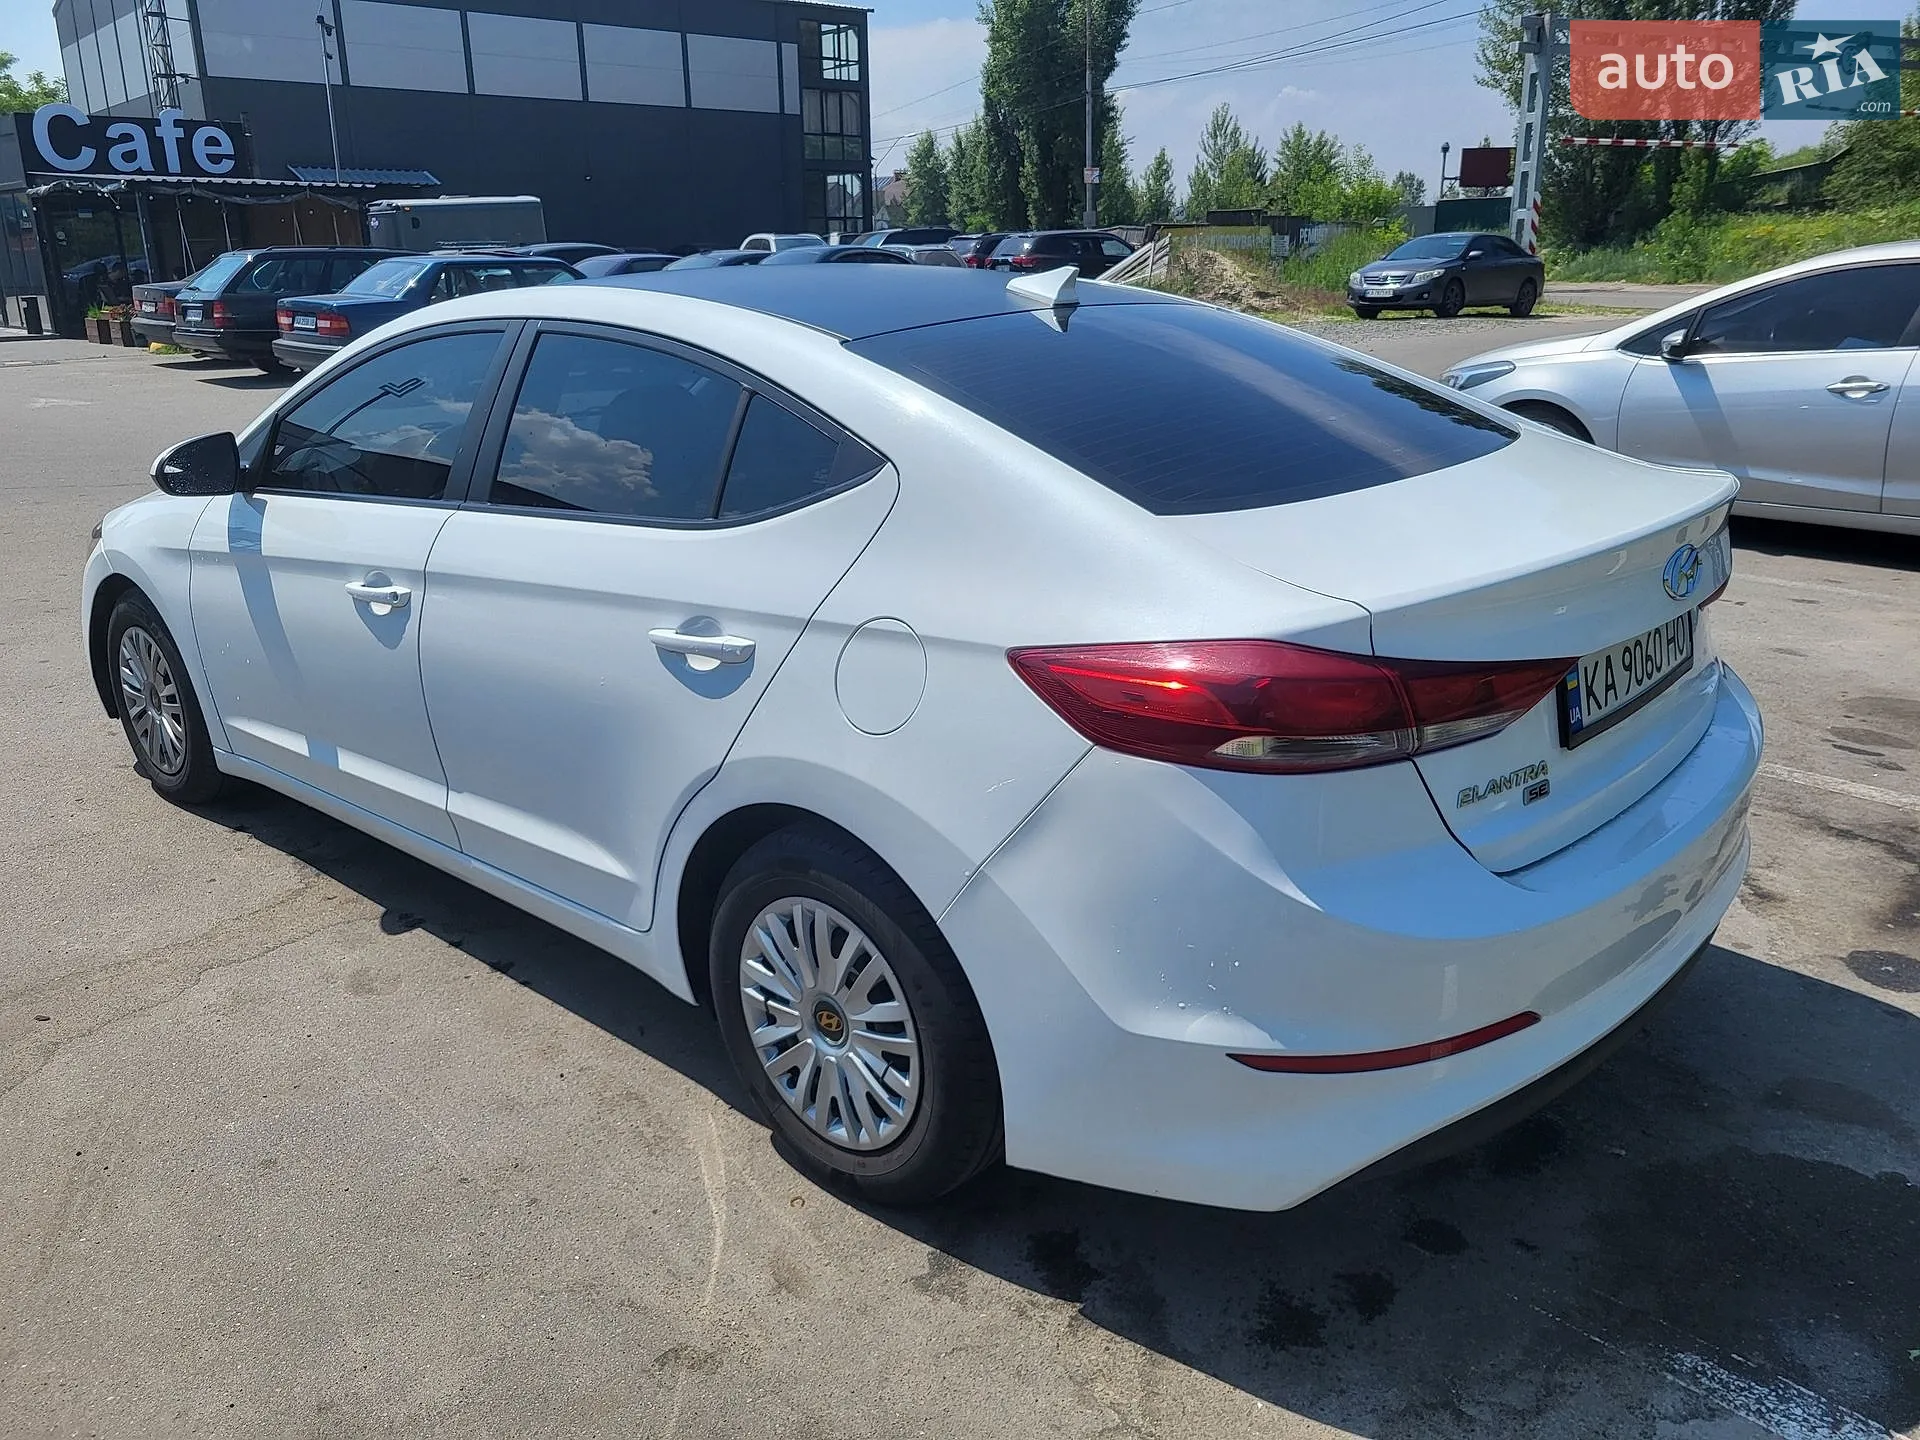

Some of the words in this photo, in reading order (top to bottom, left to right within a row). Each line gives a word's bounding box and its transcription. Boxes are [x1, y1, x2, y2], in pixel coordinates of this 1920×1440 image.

[32, 102, 236, 174] Cafe
[1584, 654, 1619, 716] KA
[1621, 627, 1663, 696] 9060
[1665, 614, 1686, 667] HO
[1569, 706, 1582, 724] UA
[1456, 760, 1549, 809] ELANTRA
[1526, 782, 1549, 803] SE
